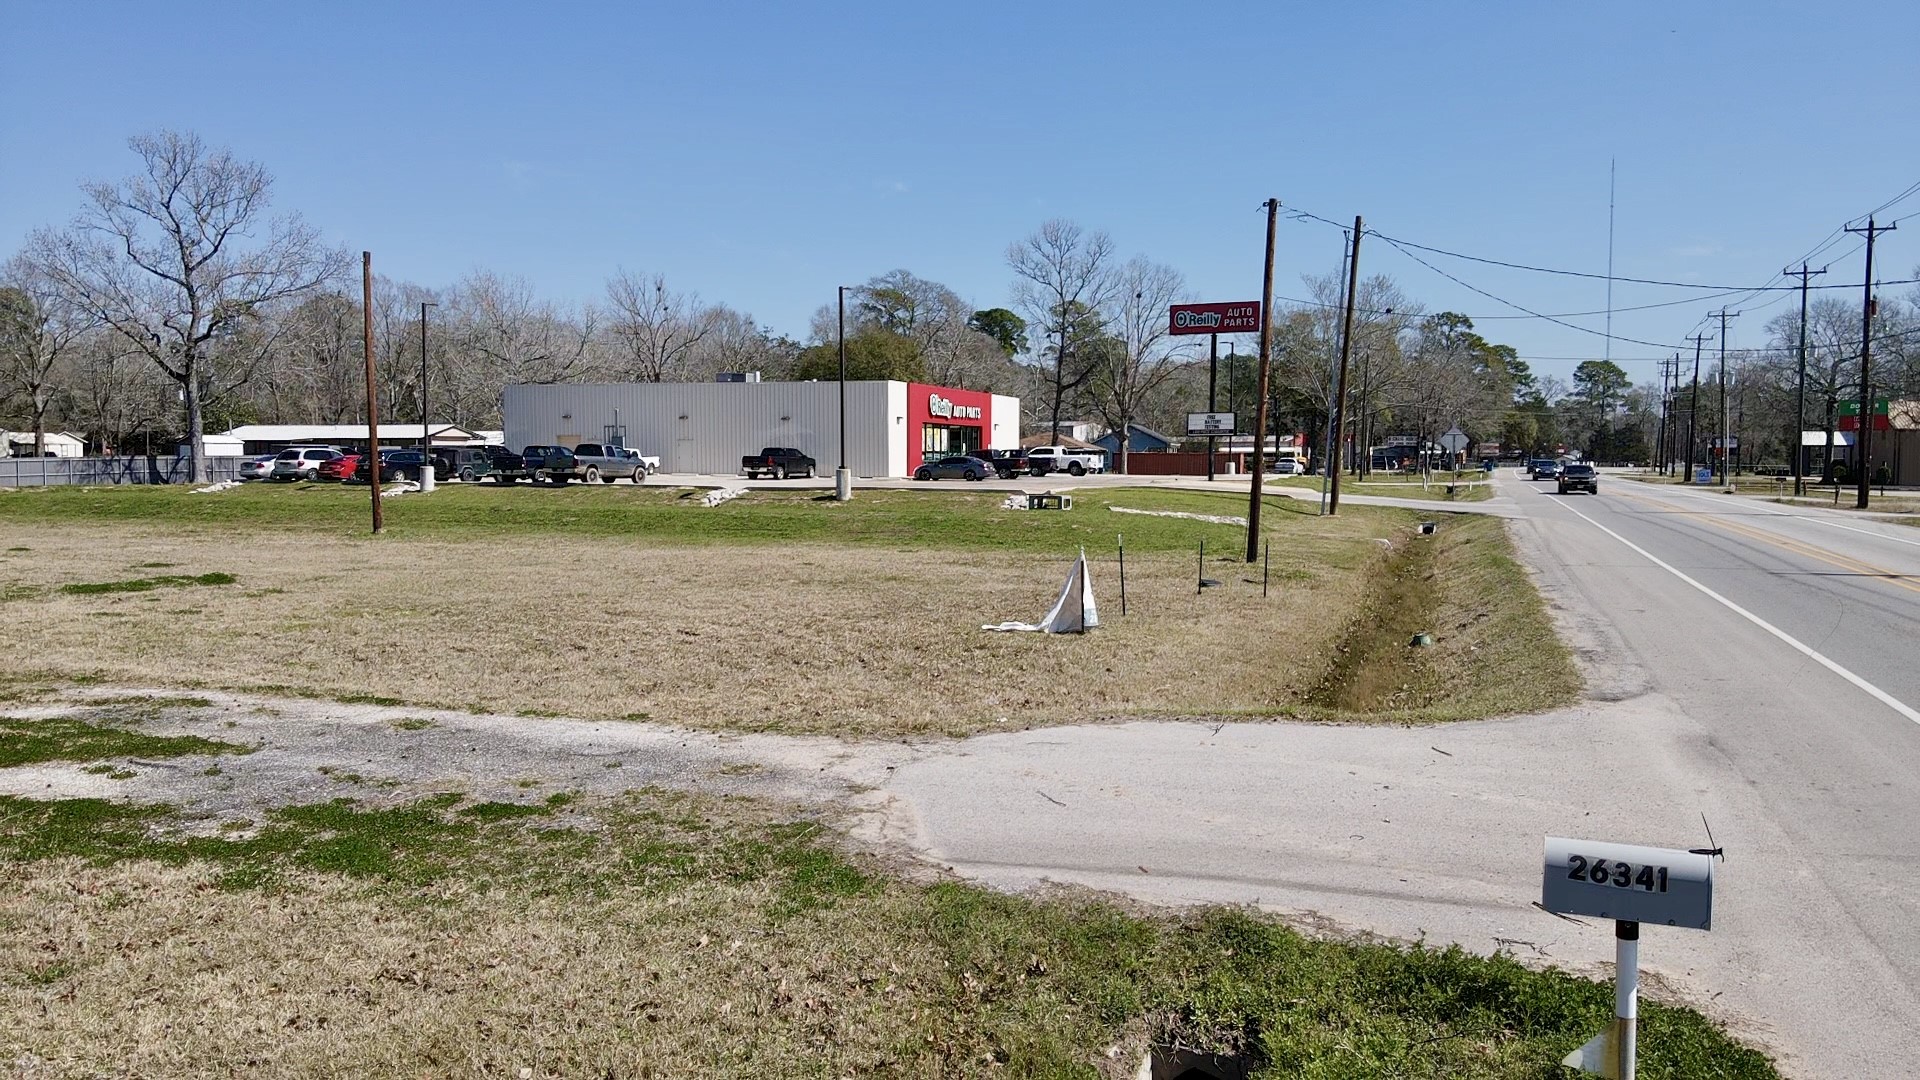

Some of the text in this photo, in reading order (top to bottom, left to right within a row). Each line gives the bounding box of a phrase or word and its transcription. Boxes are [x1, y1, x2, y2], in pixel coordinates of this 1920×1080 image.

[1175, 307, 1252, 327] O'Reilly AUTO
[1224, 317, 1255, 327] PARTS
[953, 405, 966, 418] AUTO
[966, 406, 981, 419] PARTS
[1567, 855, 1668, 893] 26341
